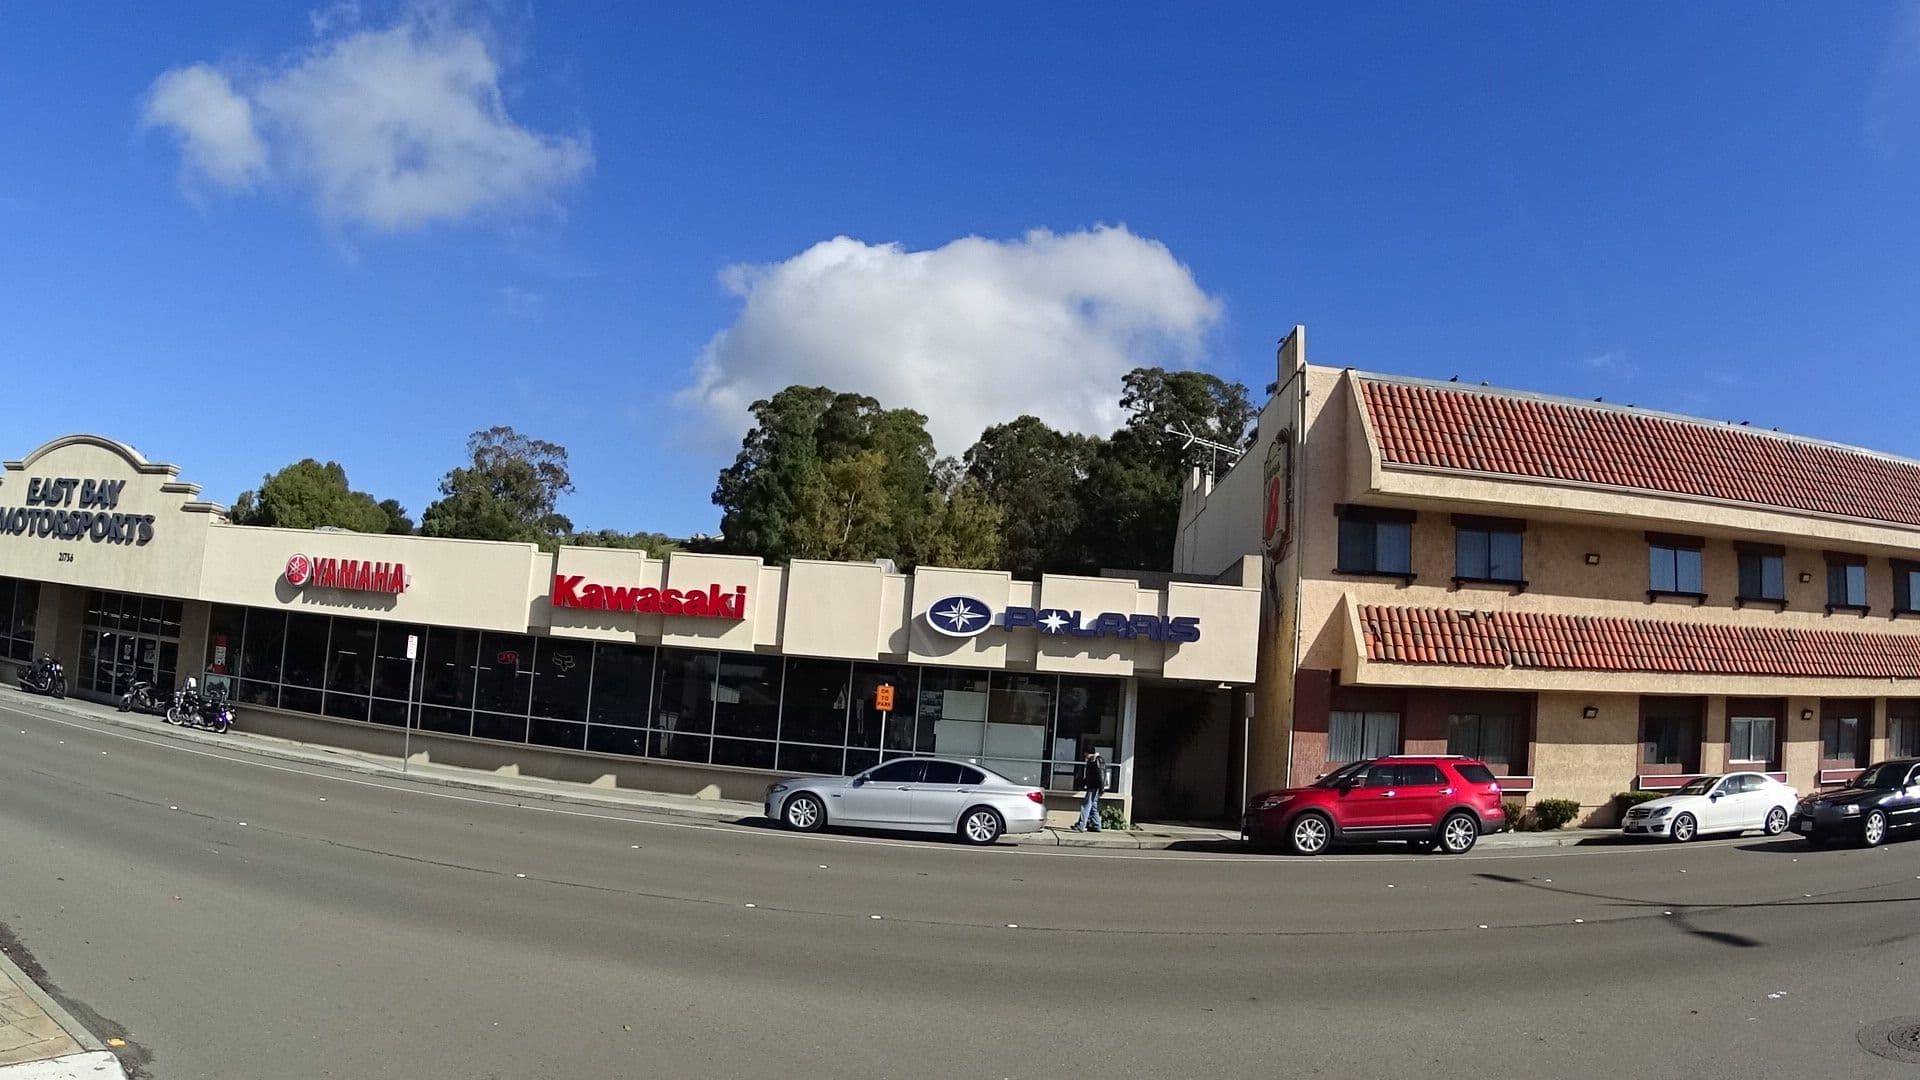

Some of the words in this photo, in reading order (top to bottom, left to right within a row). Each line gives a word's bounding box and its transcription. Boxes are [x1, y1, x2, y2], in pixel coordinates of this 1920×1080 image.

[27, 478, 79, 507] EAST
[80, 479, 125, 510] BAY
[0, 507, 155, 546] MOTORSPORTS
[312, 556, 404, 593] YAMAHA
[553, 575, 746, 619] Kawasaki
[1003, 606, 1201, 642] POLARIS
